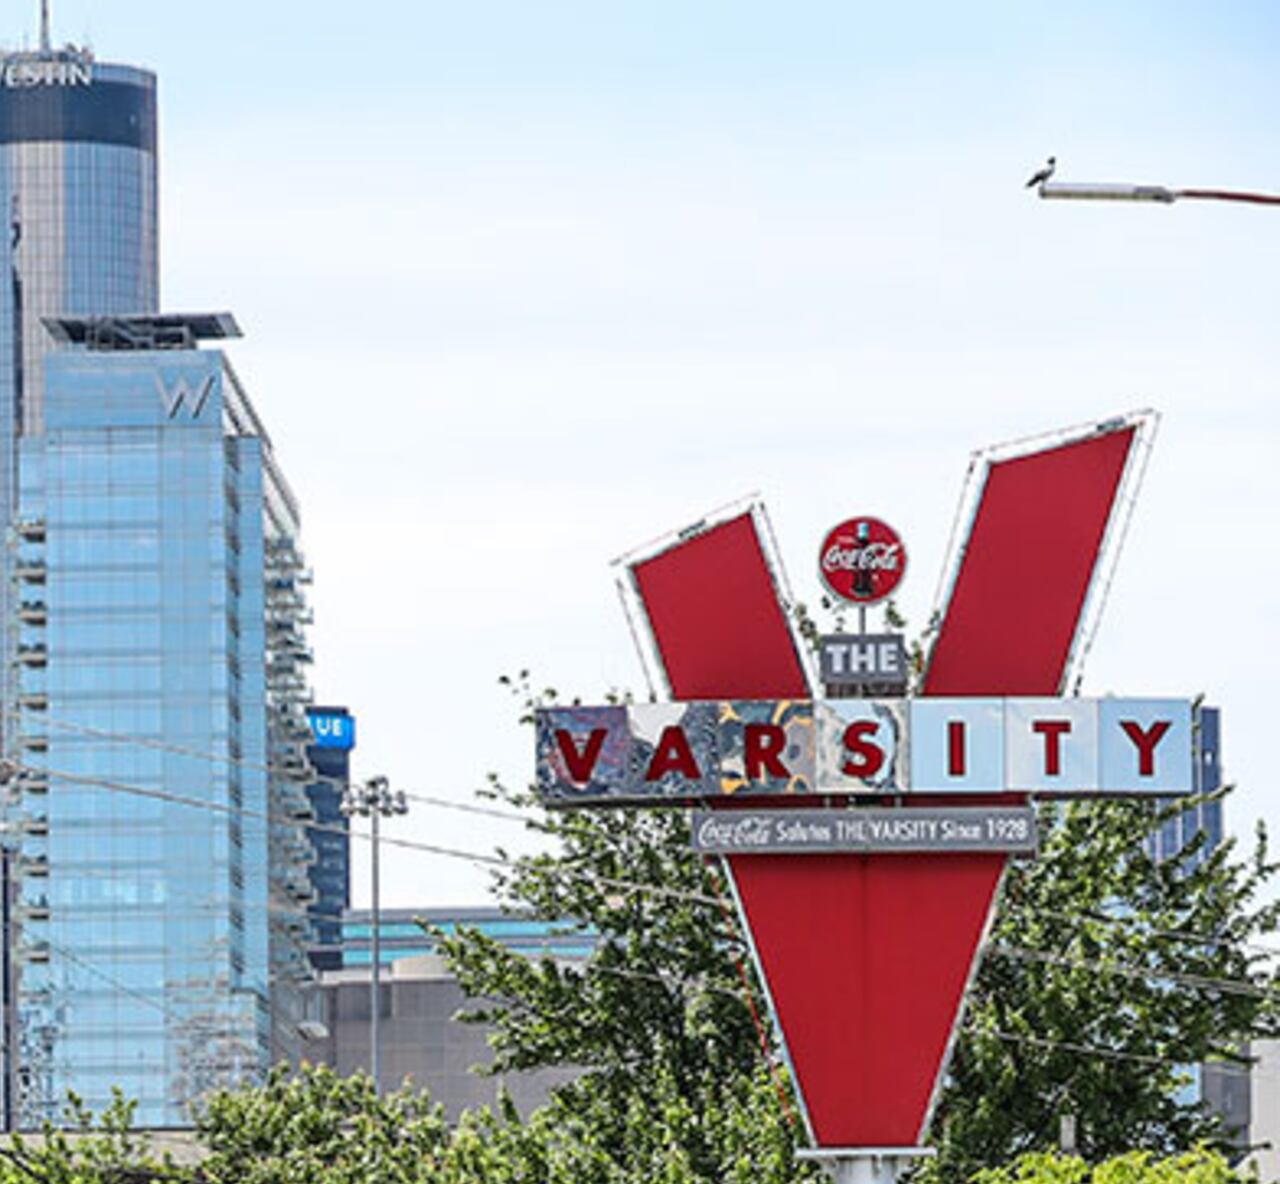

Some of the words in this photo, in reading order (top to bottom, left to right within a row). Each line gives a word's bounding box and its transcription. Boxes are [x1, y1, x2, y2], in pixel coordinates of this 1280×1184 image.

[154, 370, 216, 419] W
[825, 643, 900, 673] THE
[554, 720, 1173, 785] VARSITY
[698, 817, 773, 847] Coca-Cola
[776, 819, 831, 843] Salutes
[837, 819, 867, 842] THE
[868, 818, 938, 842] VARSITY
[940, 818, 981, 842] Since
[986, 817, 1029, 842] 1928
